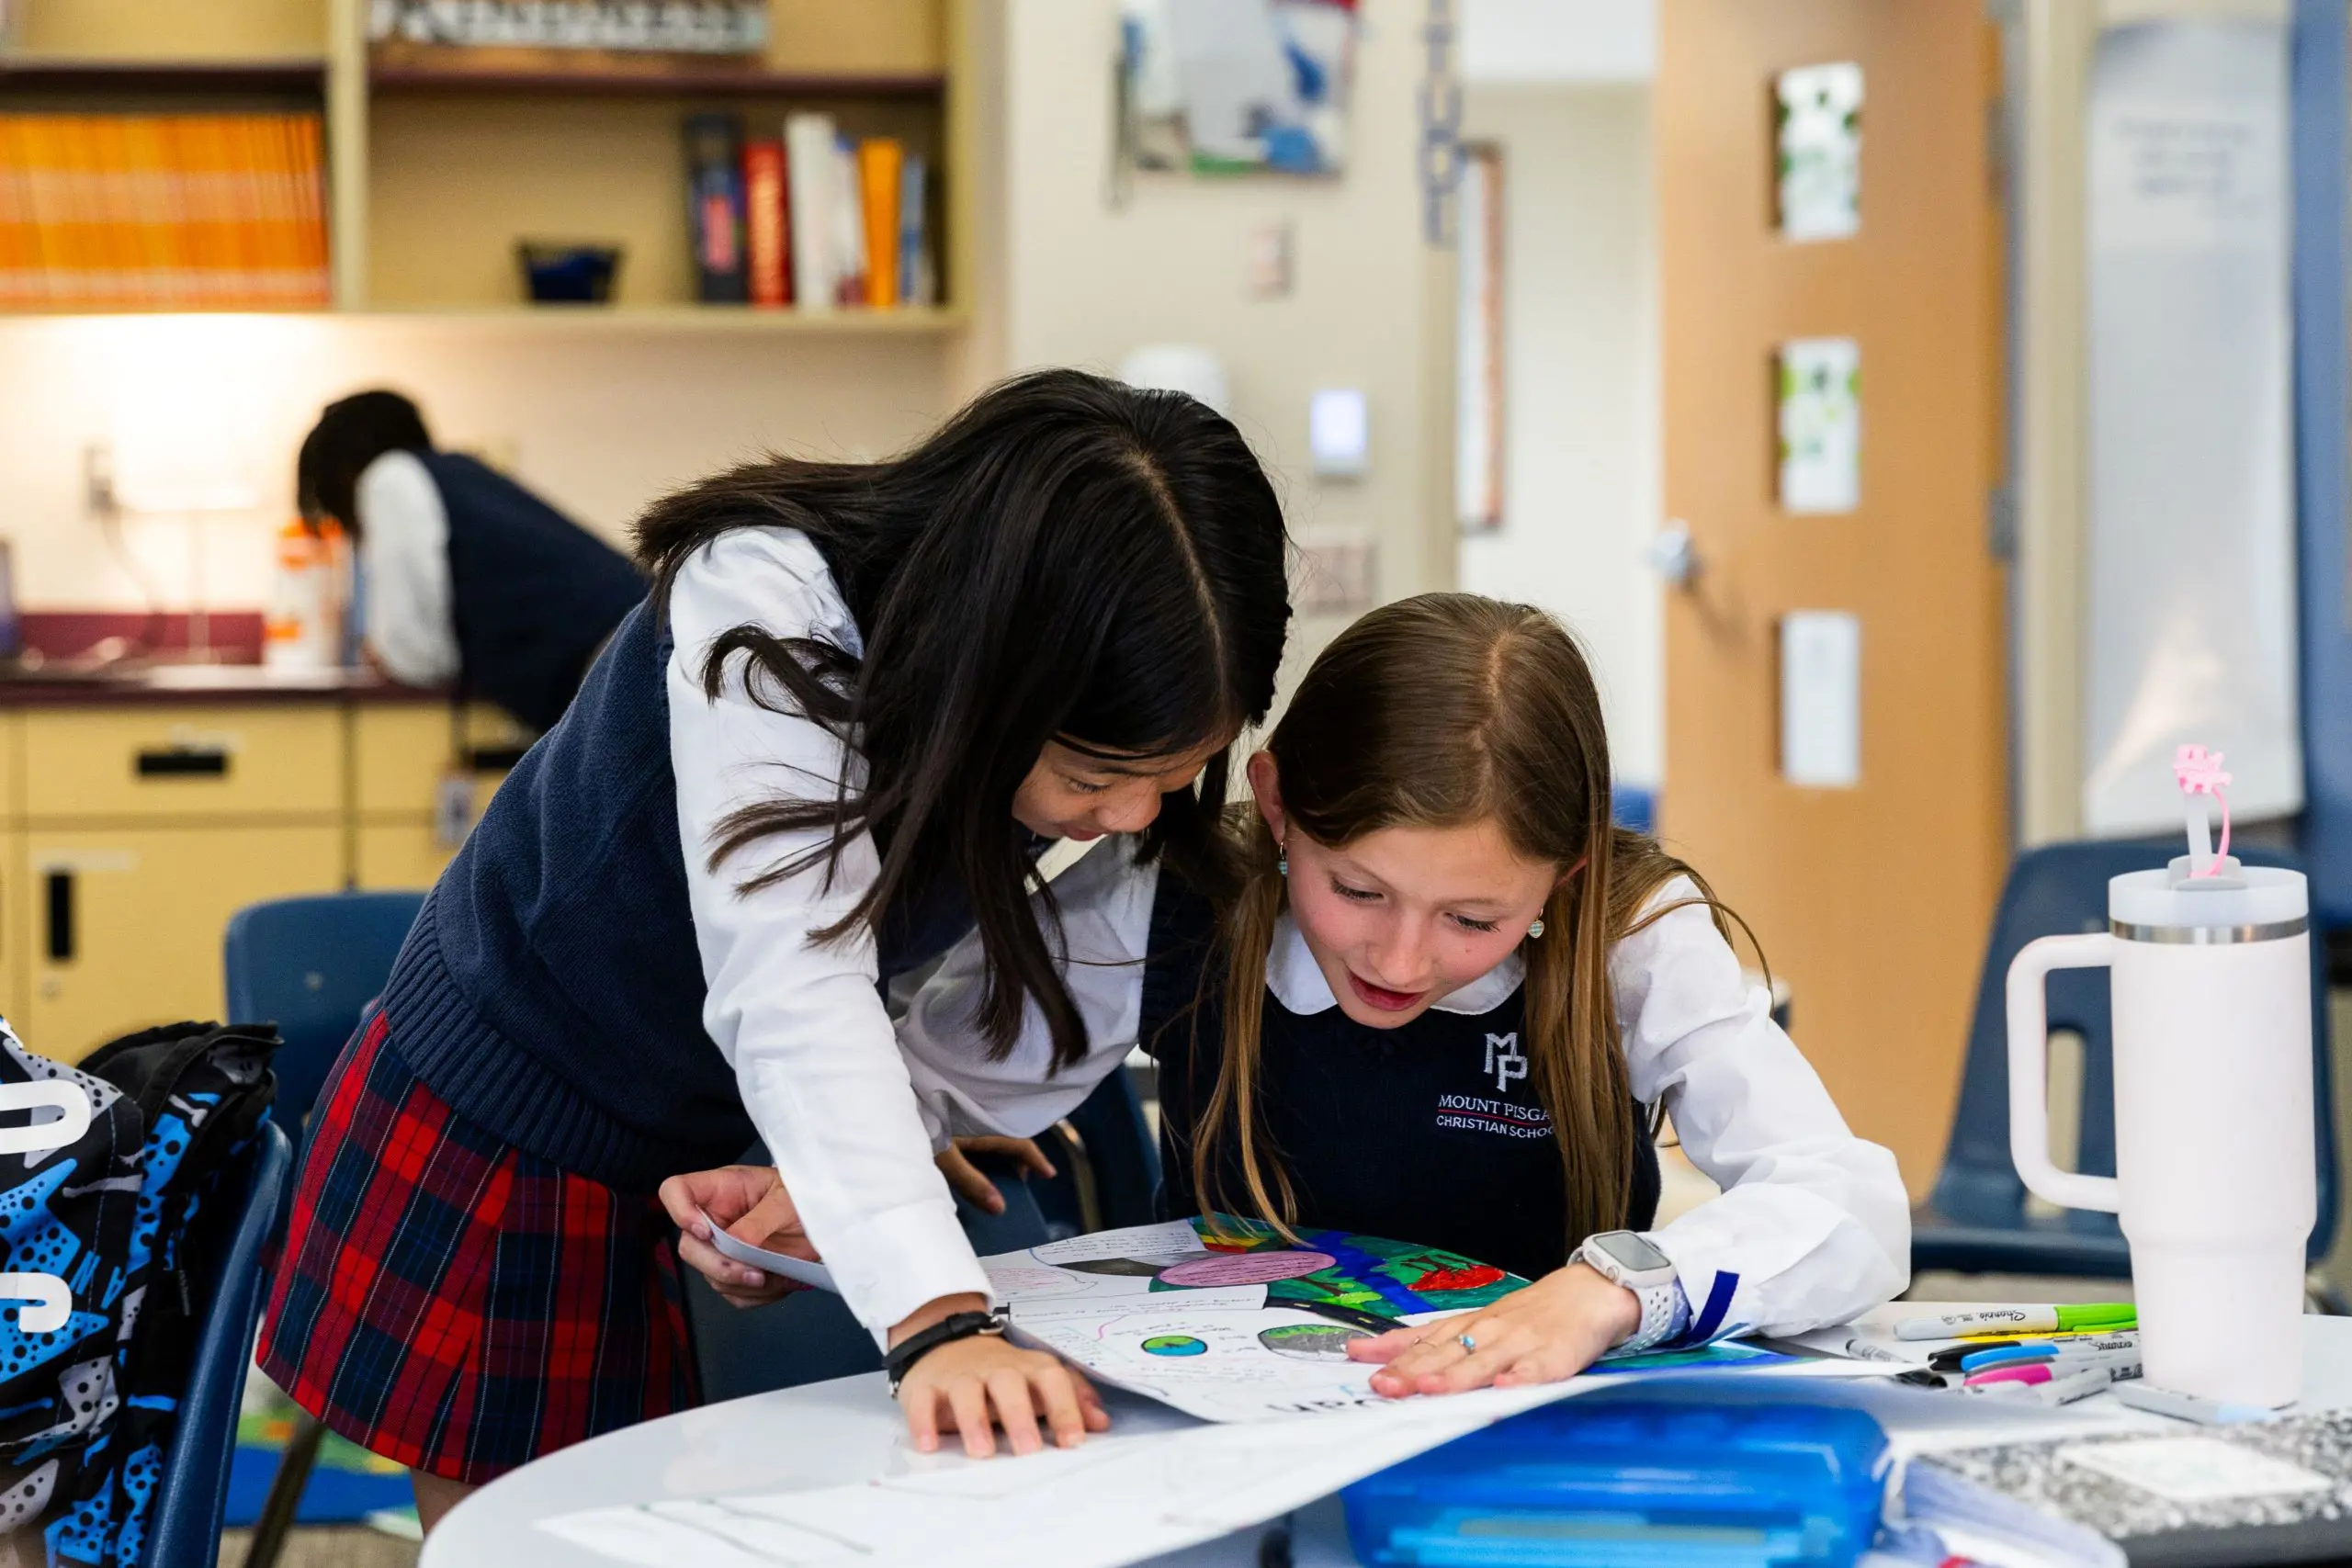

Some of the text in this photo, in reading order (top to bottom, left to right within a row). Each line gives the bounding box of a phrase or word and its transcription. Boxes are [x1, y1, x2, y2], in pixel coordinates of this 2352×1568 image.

[1438, 1094, 1551, 1122] MOUNT PISGA
[1436, 1115, 1555, 1139] CHRISTIAN SCHOO
